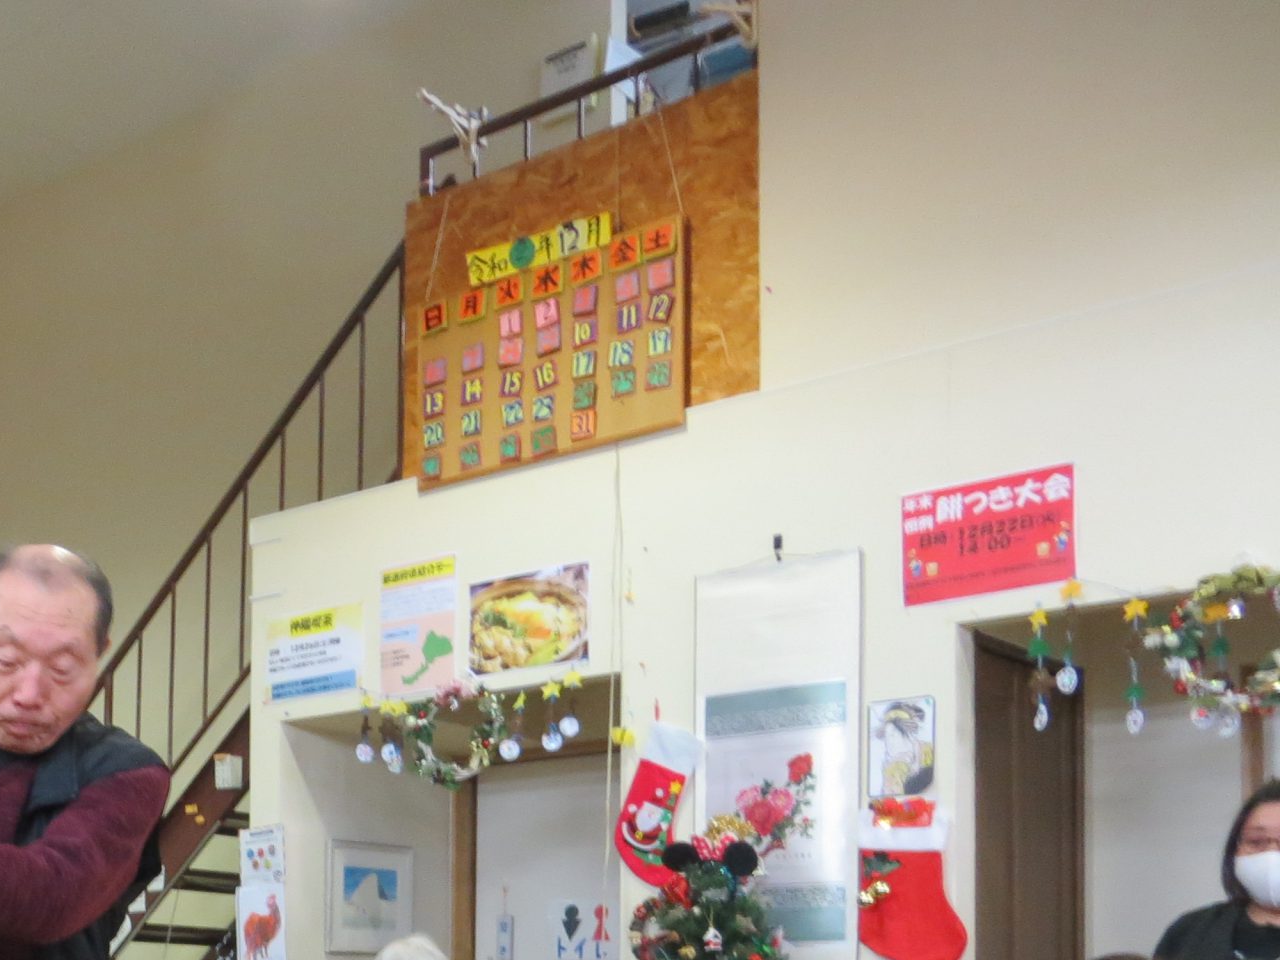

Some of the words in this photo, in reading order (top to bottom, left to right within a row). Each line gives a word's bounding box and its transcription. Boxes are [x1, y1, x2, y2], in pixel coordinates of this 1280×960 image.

[424, 303, 444, 332] 日
[463, 294, 479, 317] 月
[499, 279, 521, 301] 火
[534, 263, 559, 294] 水
[572, 254, 596, 280] 木
[611, 238, 636, 266] 金
[644, 228, 670, 254] 土
[573, 321, 592, 346] 10
[621, 303, 638, 332] 11
[648, 293, 670, 321] 12
[425, 391, 444, 416] 13
[464, 378, 482, 403] 14
[503, 371, 522, 396] 15
[535, 361, 555, 389] 16
[423, 421, 444, 448] 20
